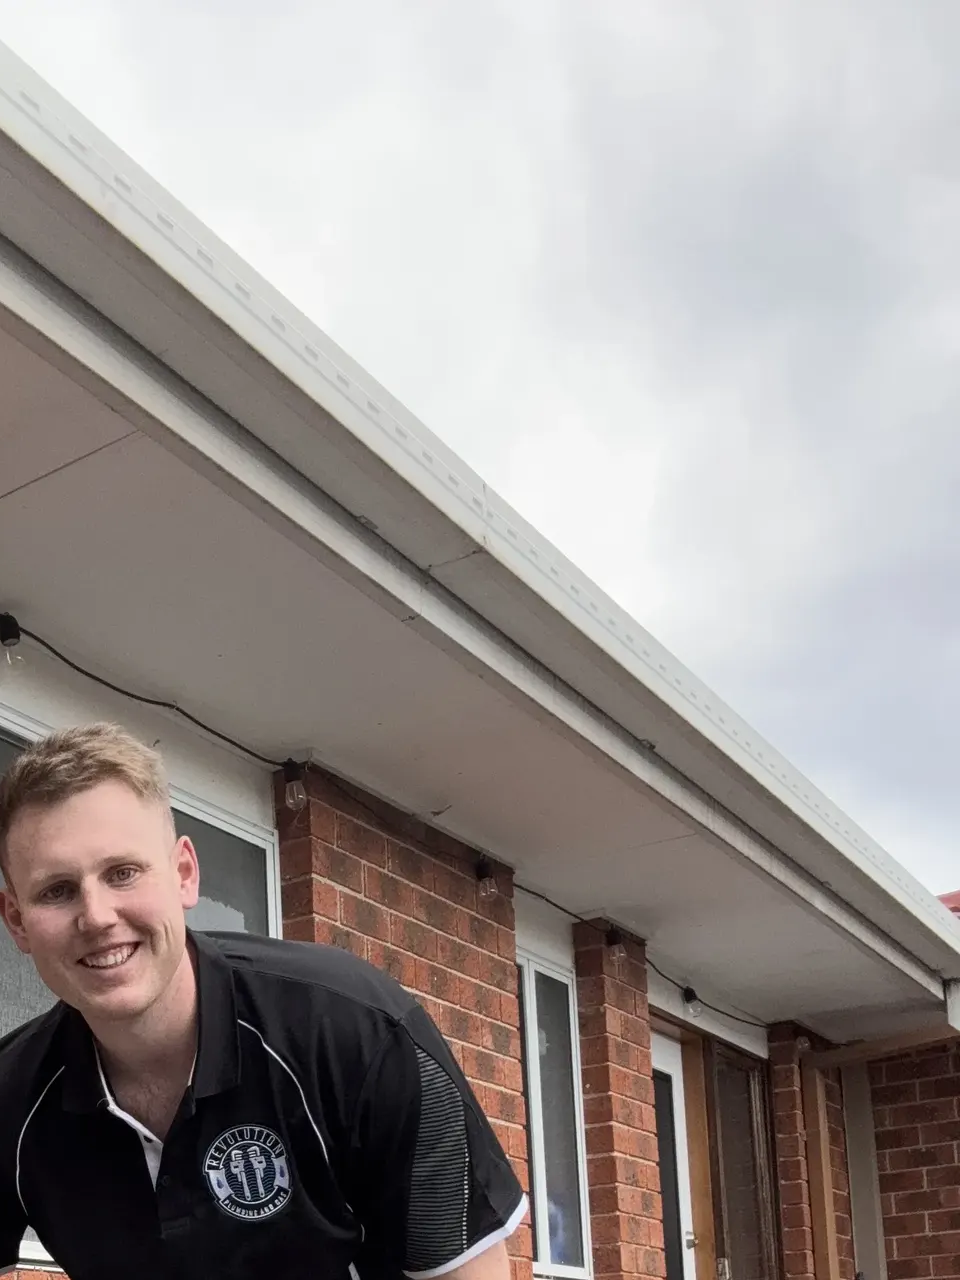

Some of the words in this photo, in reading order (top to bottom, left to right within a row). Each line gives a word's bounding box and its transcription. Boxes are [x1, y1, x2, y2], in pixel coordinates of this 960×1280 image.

[208, 1127, 283, 1167] REVOLUTION
[223, 1199, 258, 1216] PLUMBING
[260, 1203, 274, 1215] AND
[274, 1191, 287, 1205] GAS
